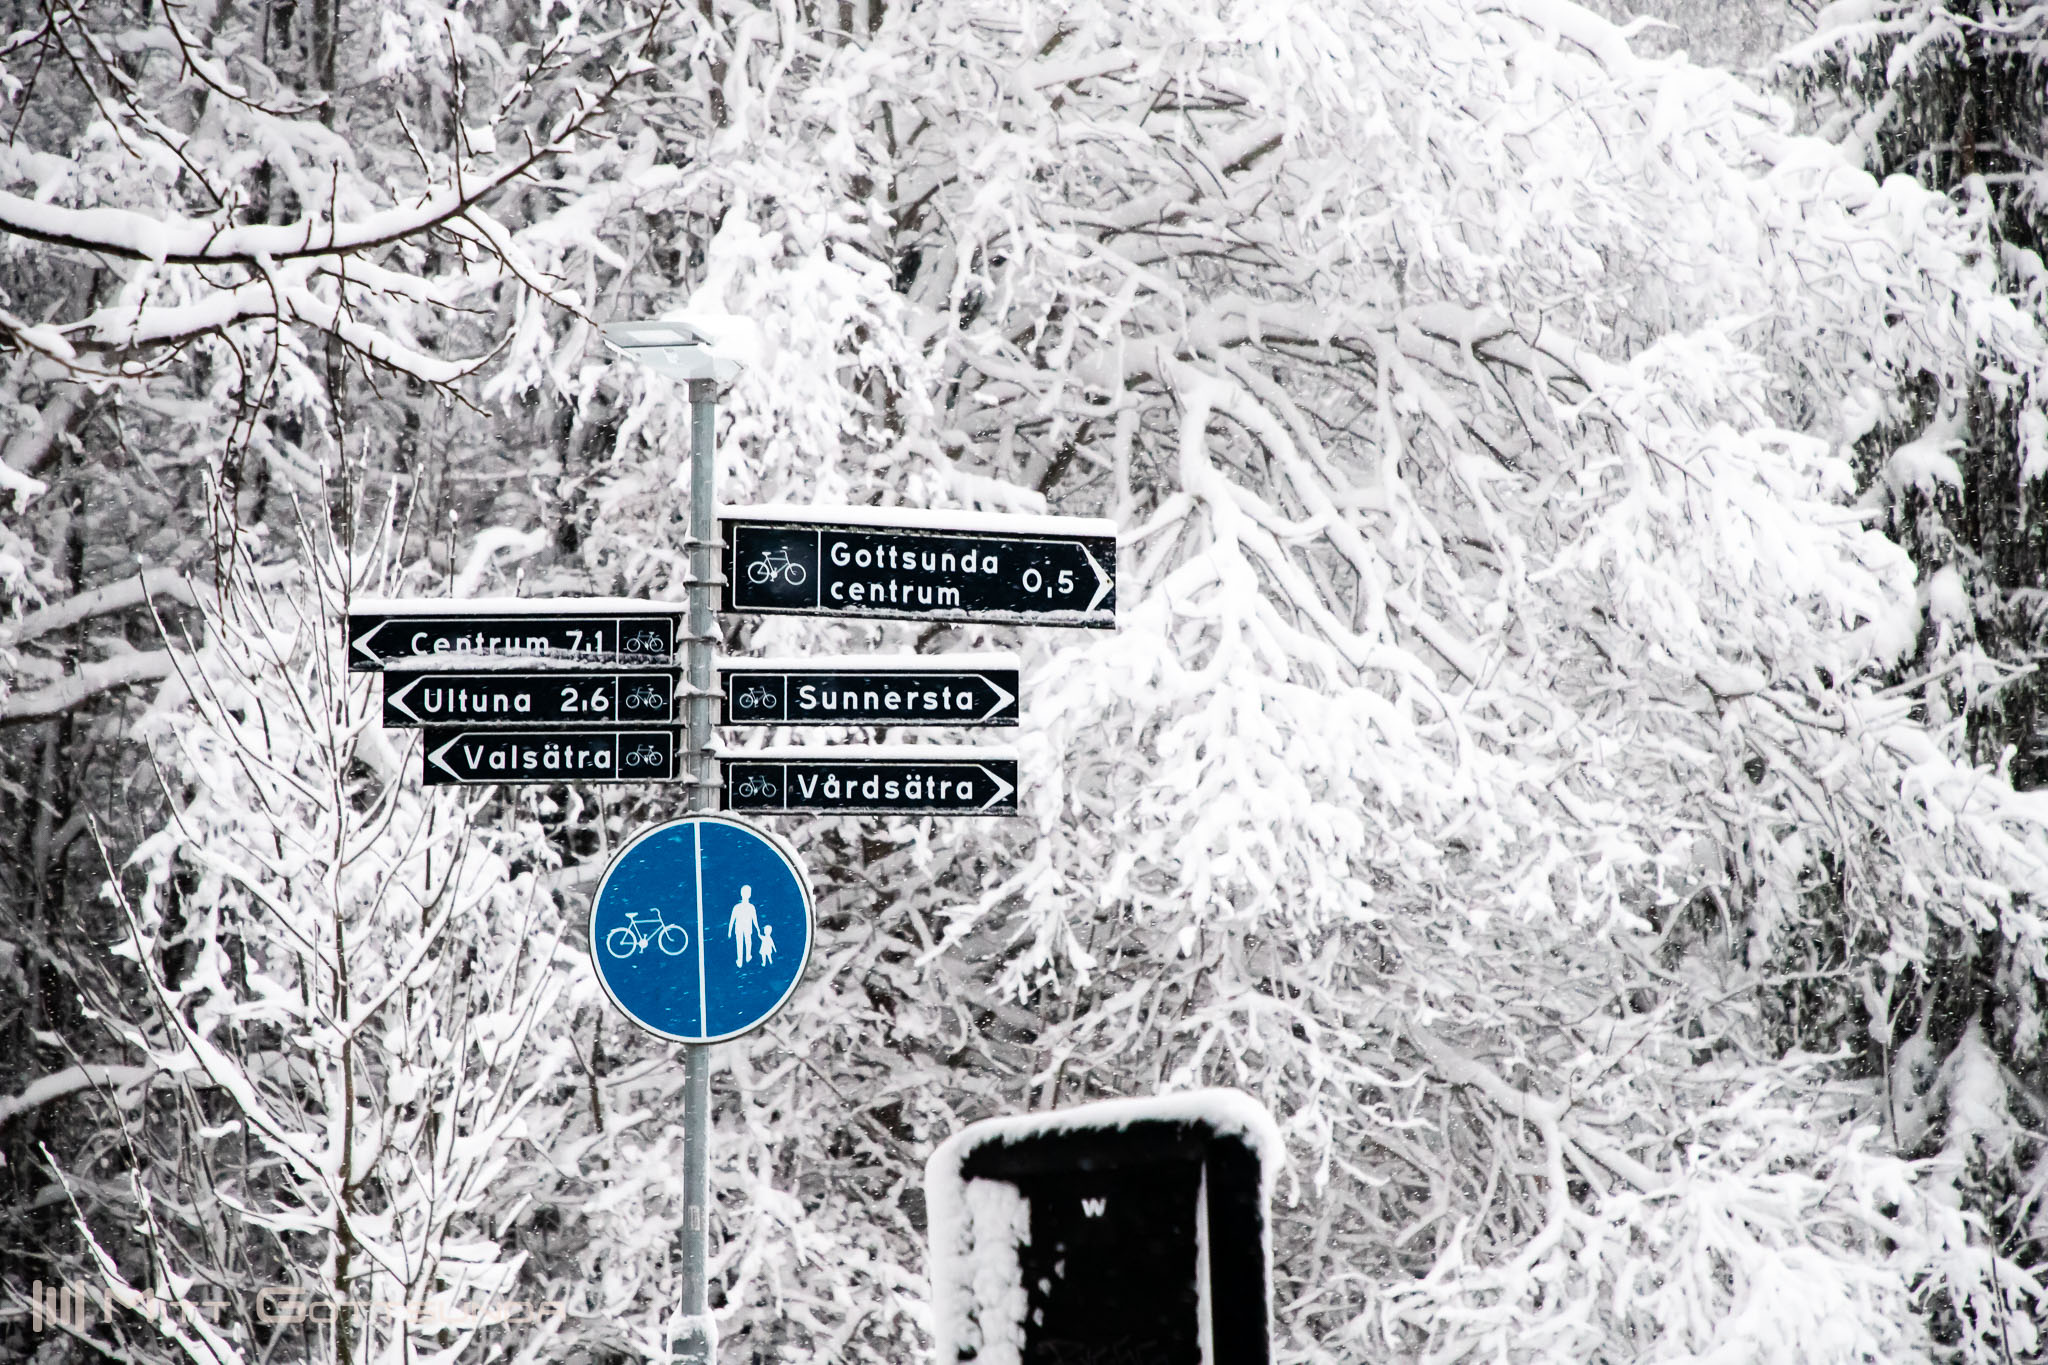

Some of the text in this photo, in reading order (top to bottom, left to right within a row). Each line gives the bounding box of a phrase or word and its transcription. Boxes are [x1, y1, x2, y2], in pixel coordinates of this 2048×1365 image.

[831, 541, 998, 574] Gottsunda
[830, 581, 960, 606] centrum
[1022, 569, 1074, 598] 0,5
[412, 632, 549, 656] Centrum
[424, 688, 609, 712] Ultuna 2,6
[799, 685, 973, 710] Sunnersta
[464, 744, 611, 770] Valsätra
[797, 775, 973, 799] Vårdsätra
